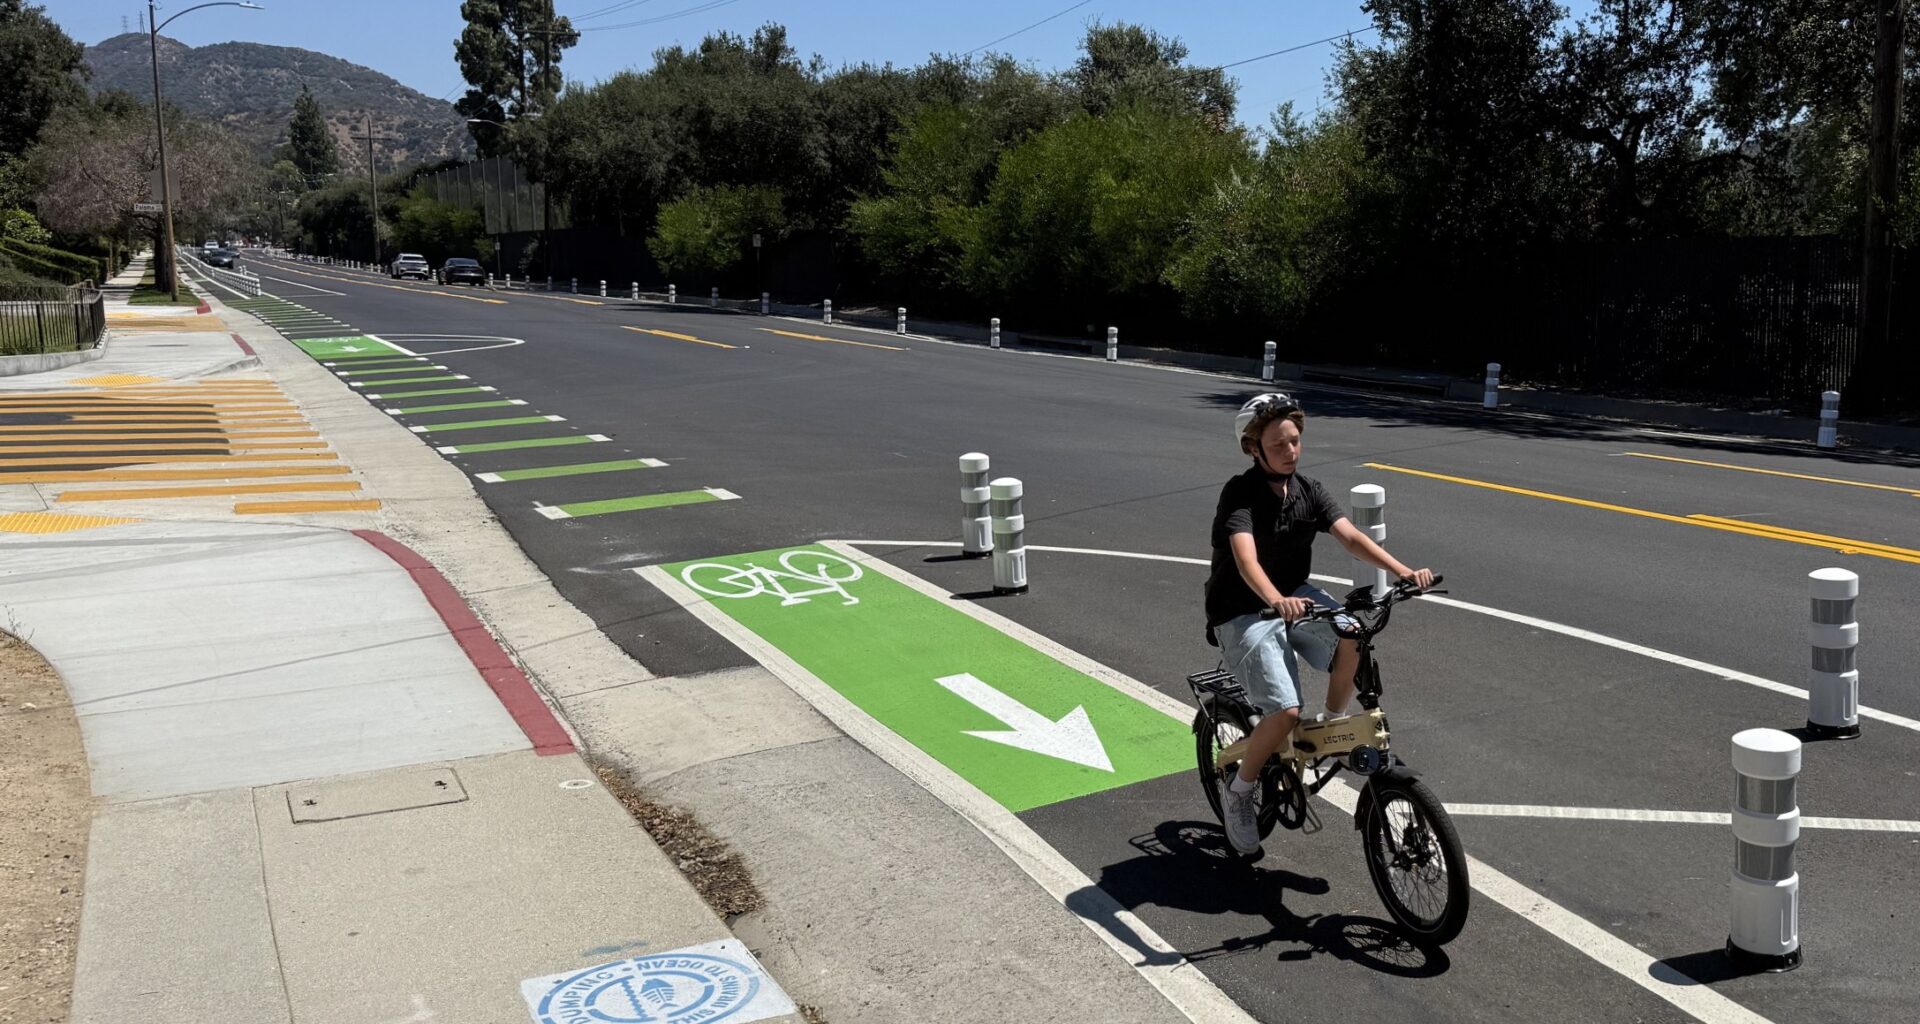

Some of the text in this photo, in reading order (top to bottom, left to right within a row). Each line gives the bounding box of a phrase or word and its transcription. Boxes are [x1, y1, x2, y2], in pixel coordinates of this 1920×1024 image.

[1323, 733, 1355, 744] LECTRIC
[637, 959, 705, 970] OCEAN
[703, 965, 728, 977] TO
[711, 975, 740, 1008] DRAINS
